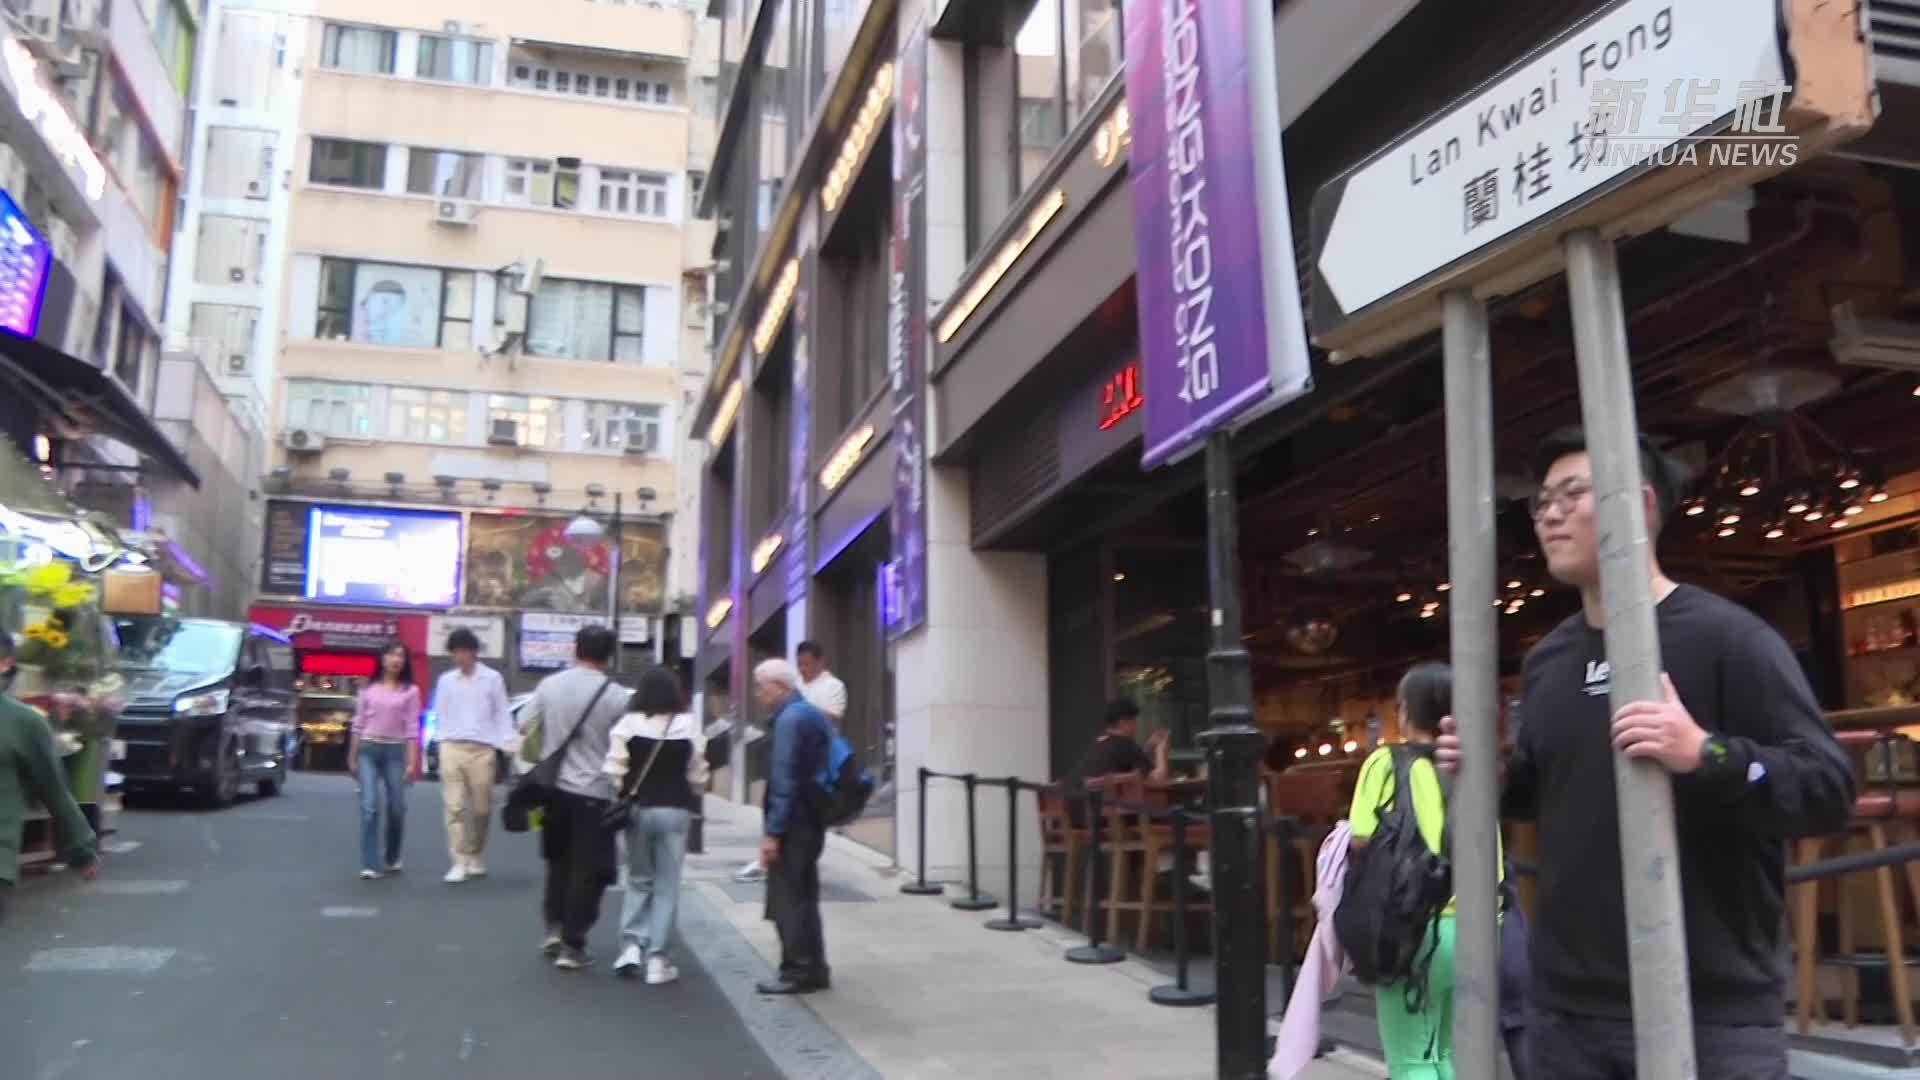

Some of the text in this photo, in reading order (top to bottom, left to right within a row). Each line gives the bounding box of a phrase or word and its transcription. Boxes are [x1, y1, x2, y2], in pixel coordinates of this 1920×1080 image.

[1410, 6, 1672, 186] Lan Kwai Fong
[1463, 111, 1613, 235] 蘭桂坊
[1180, 177, 1219, 400] KONG
